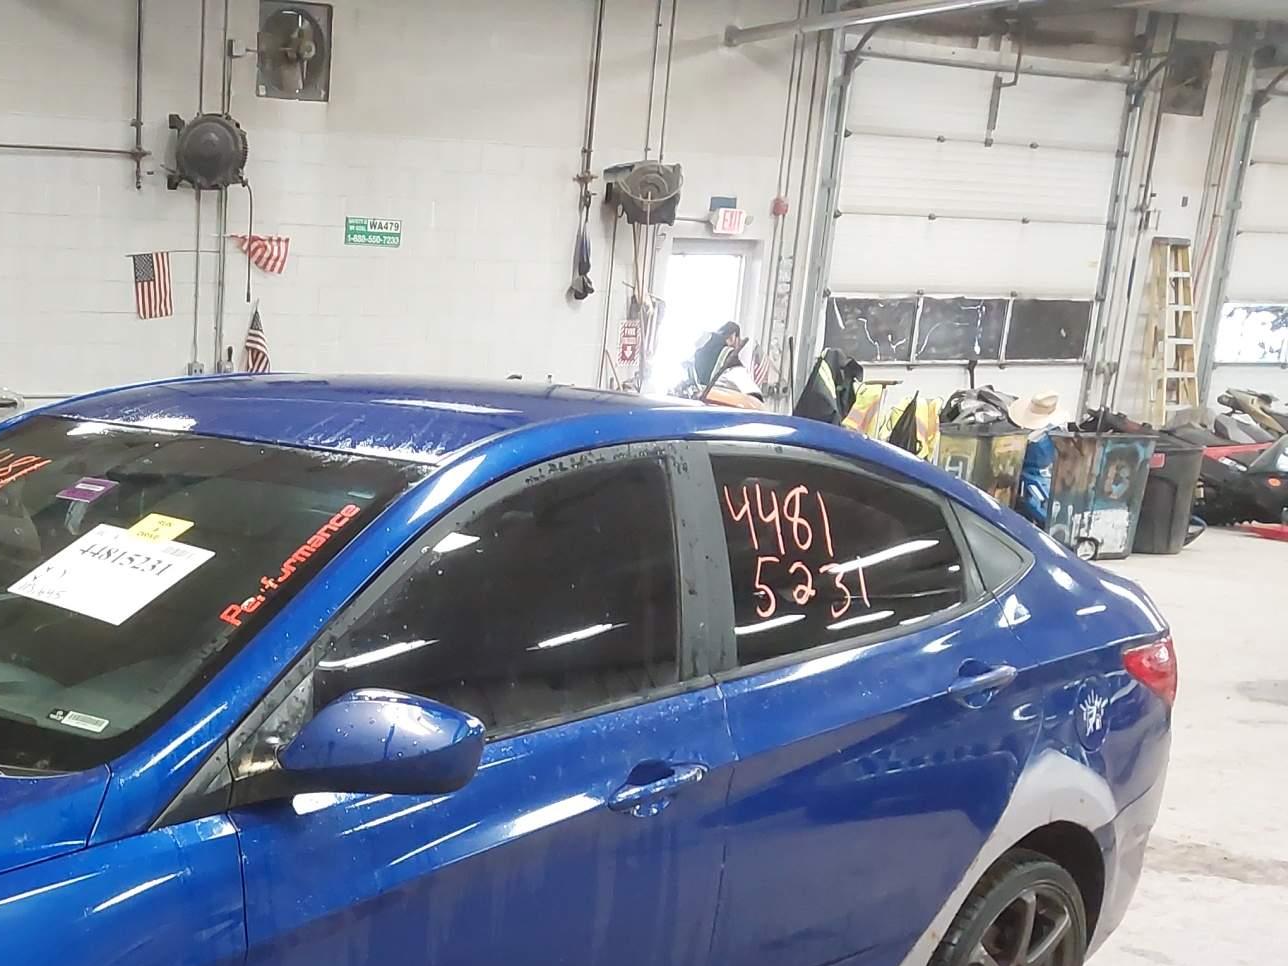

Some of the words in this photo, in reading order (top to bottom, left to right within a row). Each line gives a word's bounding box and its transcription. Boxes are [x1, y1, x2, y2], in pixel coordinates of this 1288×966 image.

[369, 219, 400, 232] WA479
[724, 484, 834, 557] 4481
[79, 543, 173, 577] 44815231
[753, 554, 871, 618] 5231
